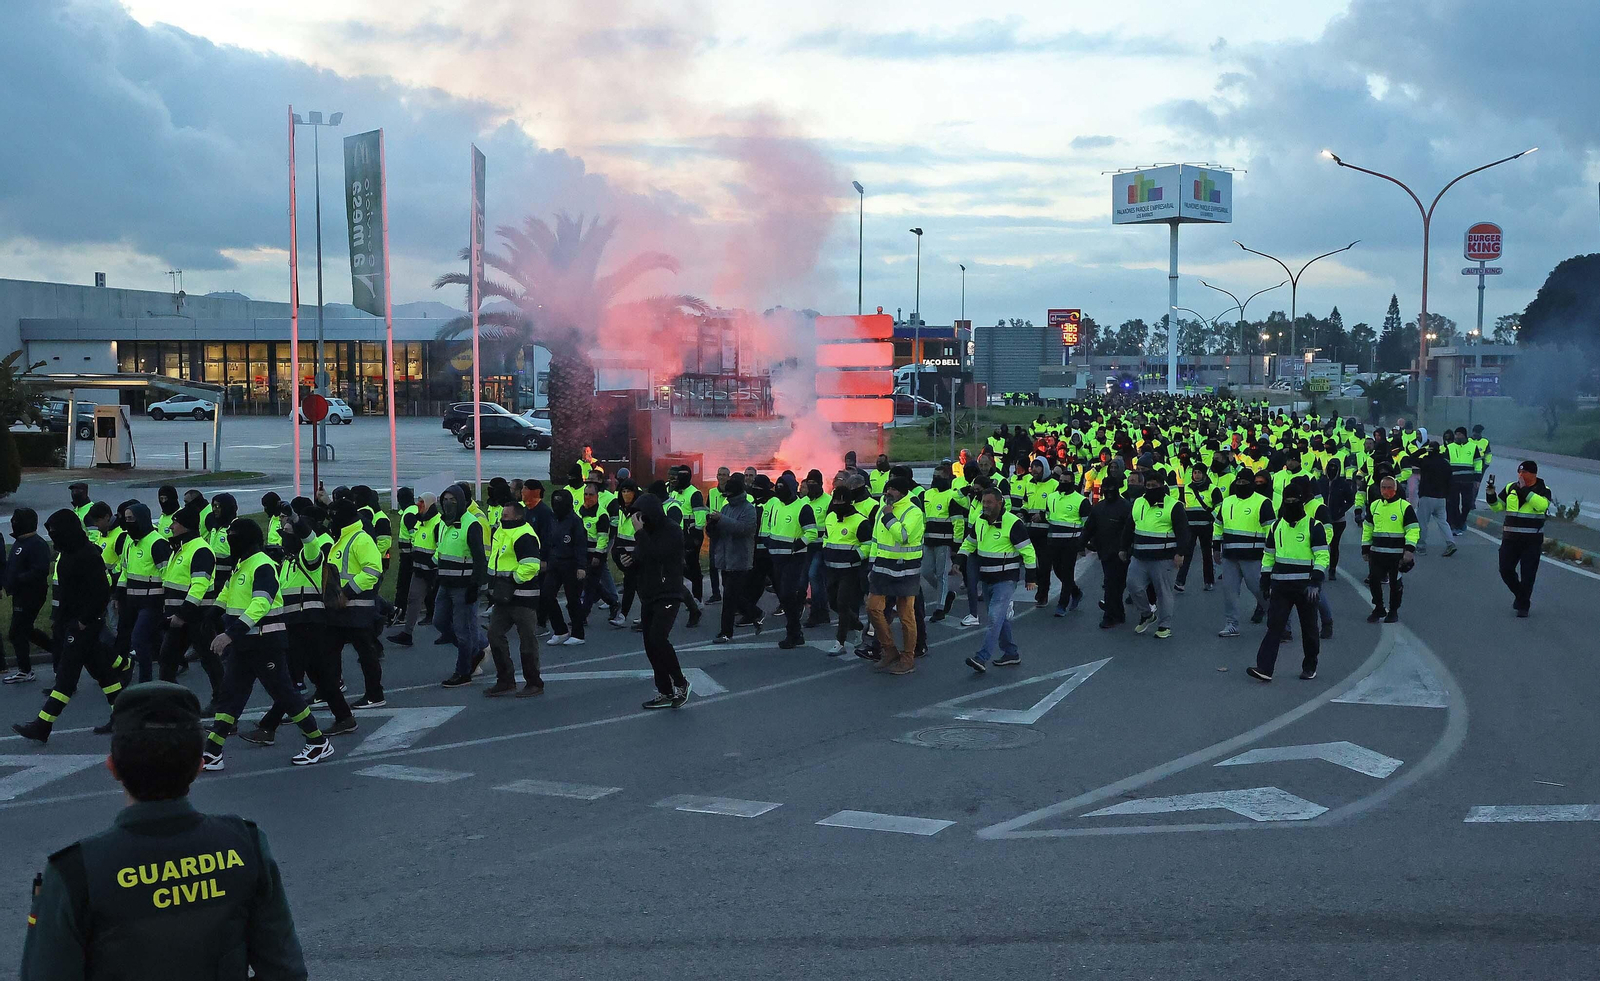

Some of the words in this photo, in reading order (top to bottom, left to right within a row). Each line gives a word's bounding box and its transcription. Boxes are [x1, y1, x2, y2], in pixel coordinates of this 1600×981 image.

[1135, 205, 1150, 213] PARQUE
[1467, 234, 1501, 242] BURGER
[1467, 242, 1501, 253] KING
[922, 358, 942, 366] TACO
[942, 358, 960, 366] BELL
[116, 849, 245, 888] GUARDIA
[152, 878, 226, 909] CIVIL
